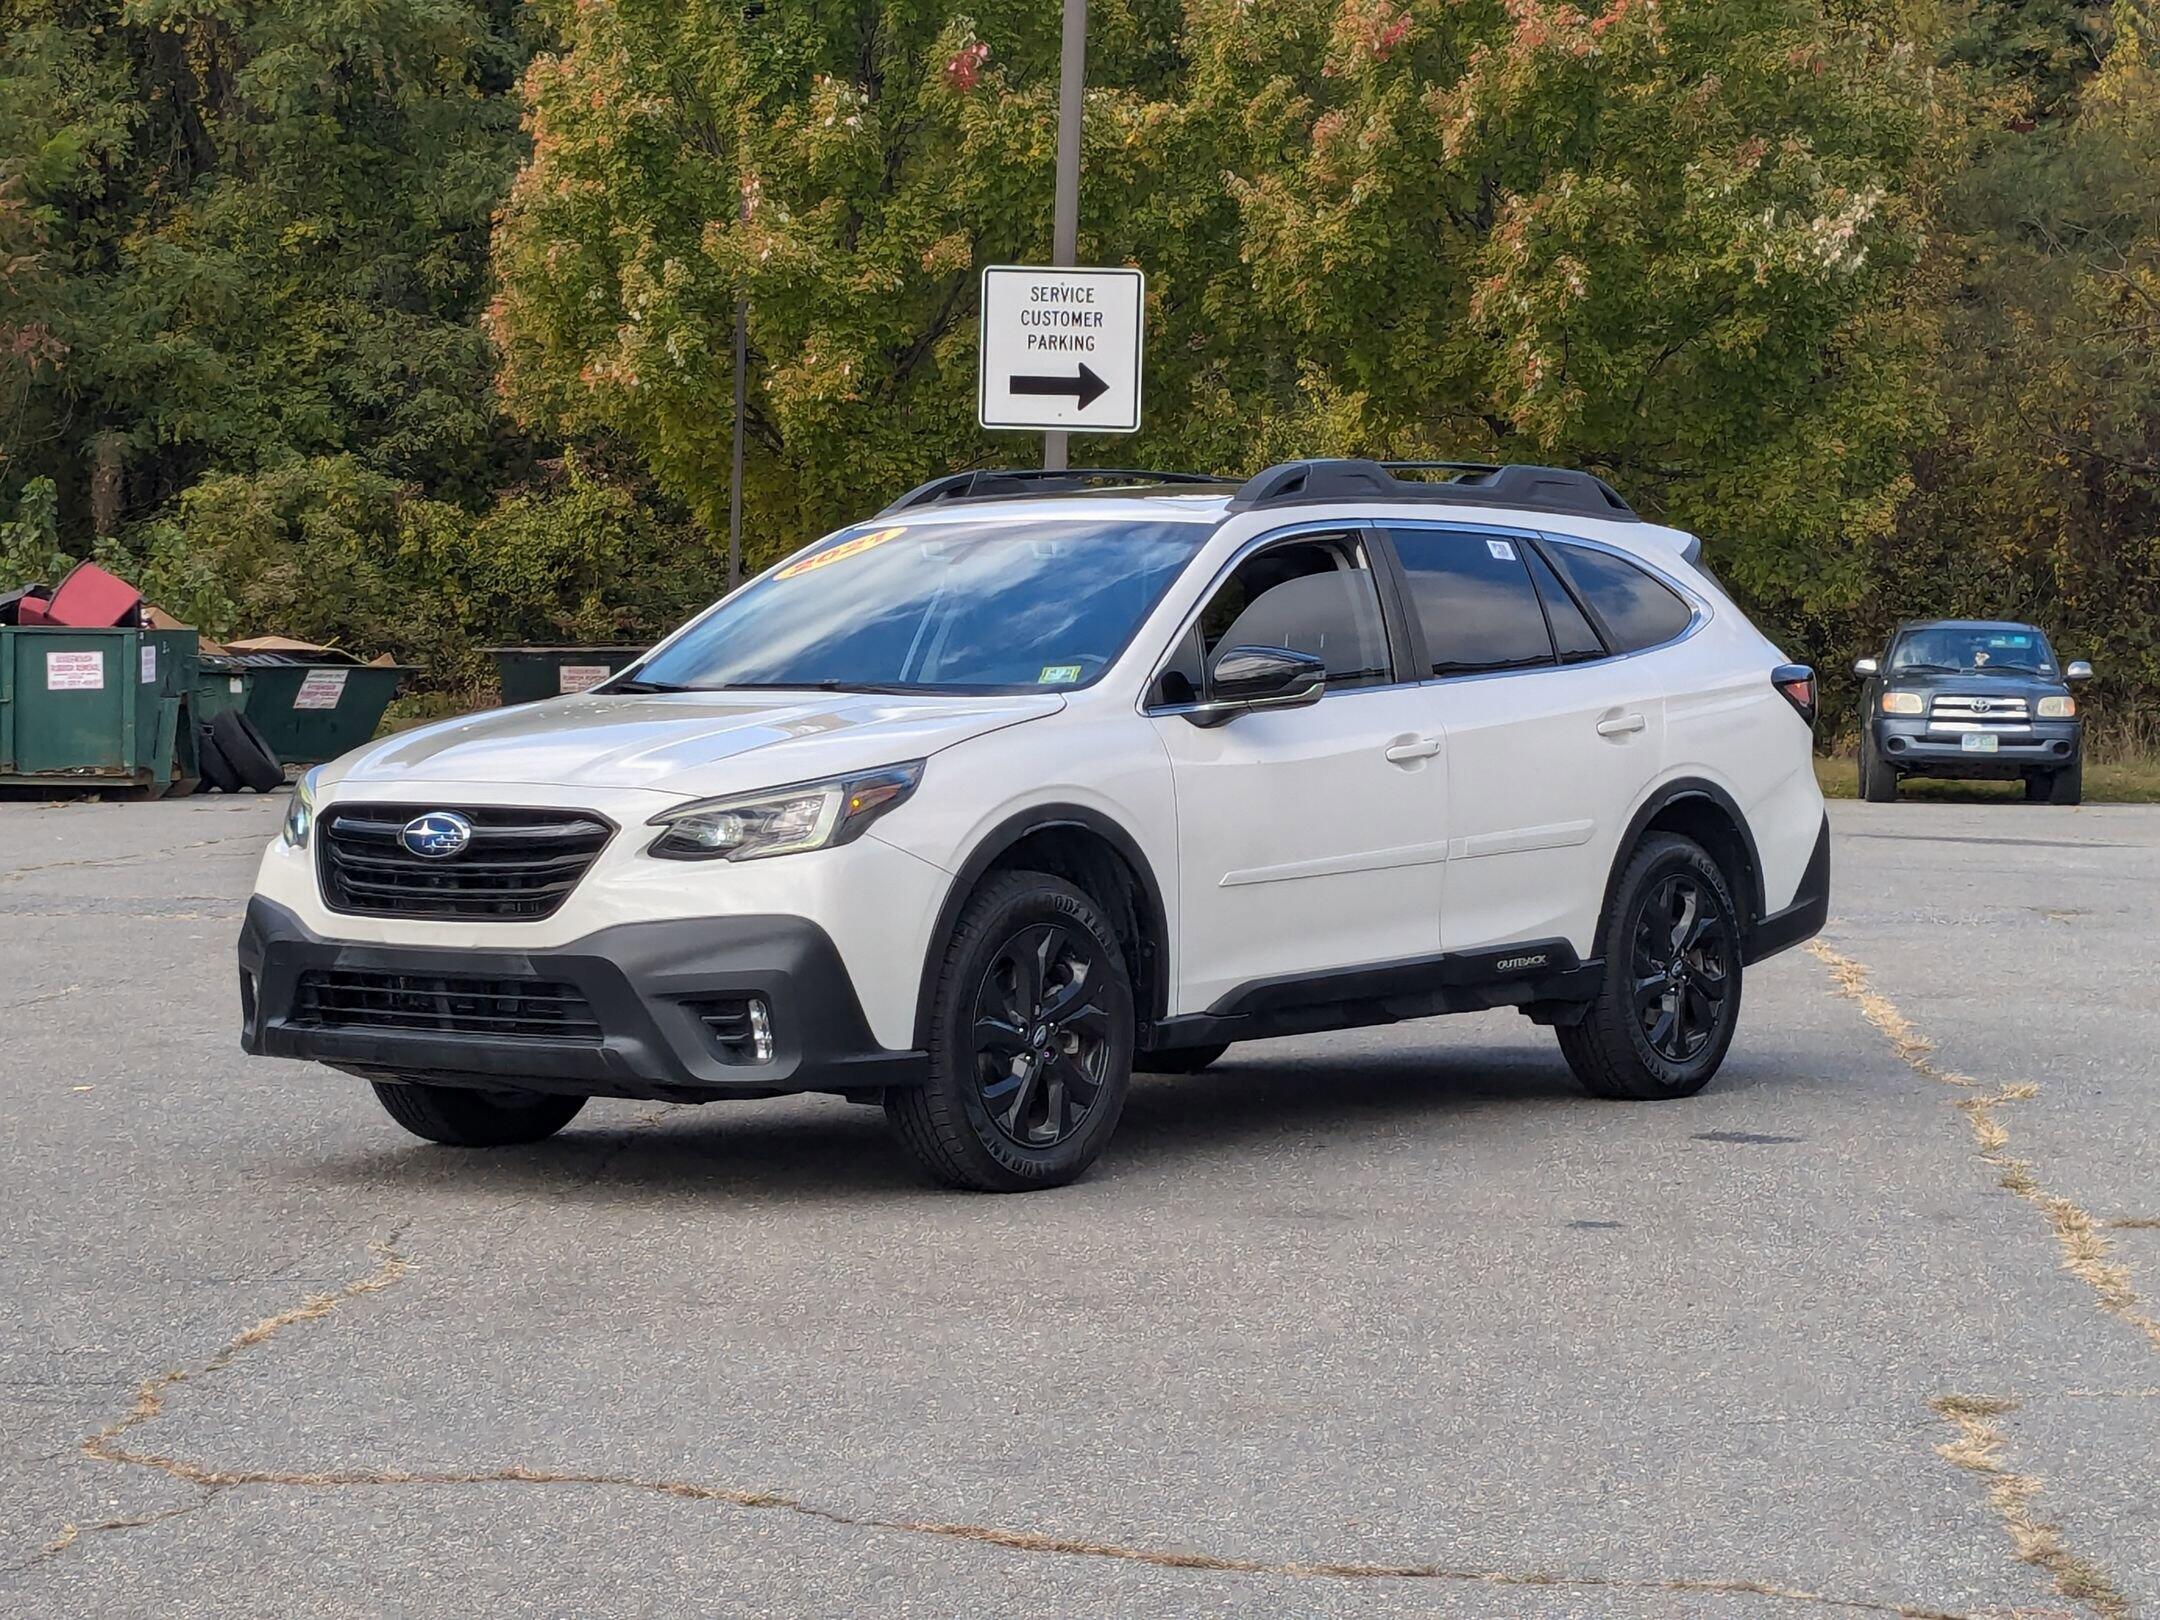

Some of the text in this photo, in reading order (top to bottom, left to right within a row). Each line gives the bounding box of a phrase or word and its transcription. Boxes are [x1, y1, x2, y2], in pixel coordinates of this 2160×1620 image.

[1030, 286, 1095, 303] SERVICE
[1020, 310, 1103, 328] CUSTOMER
[1027, 334, 1095, 351] PARKING
[1497, 955, 1546, 970] OUTBACK
